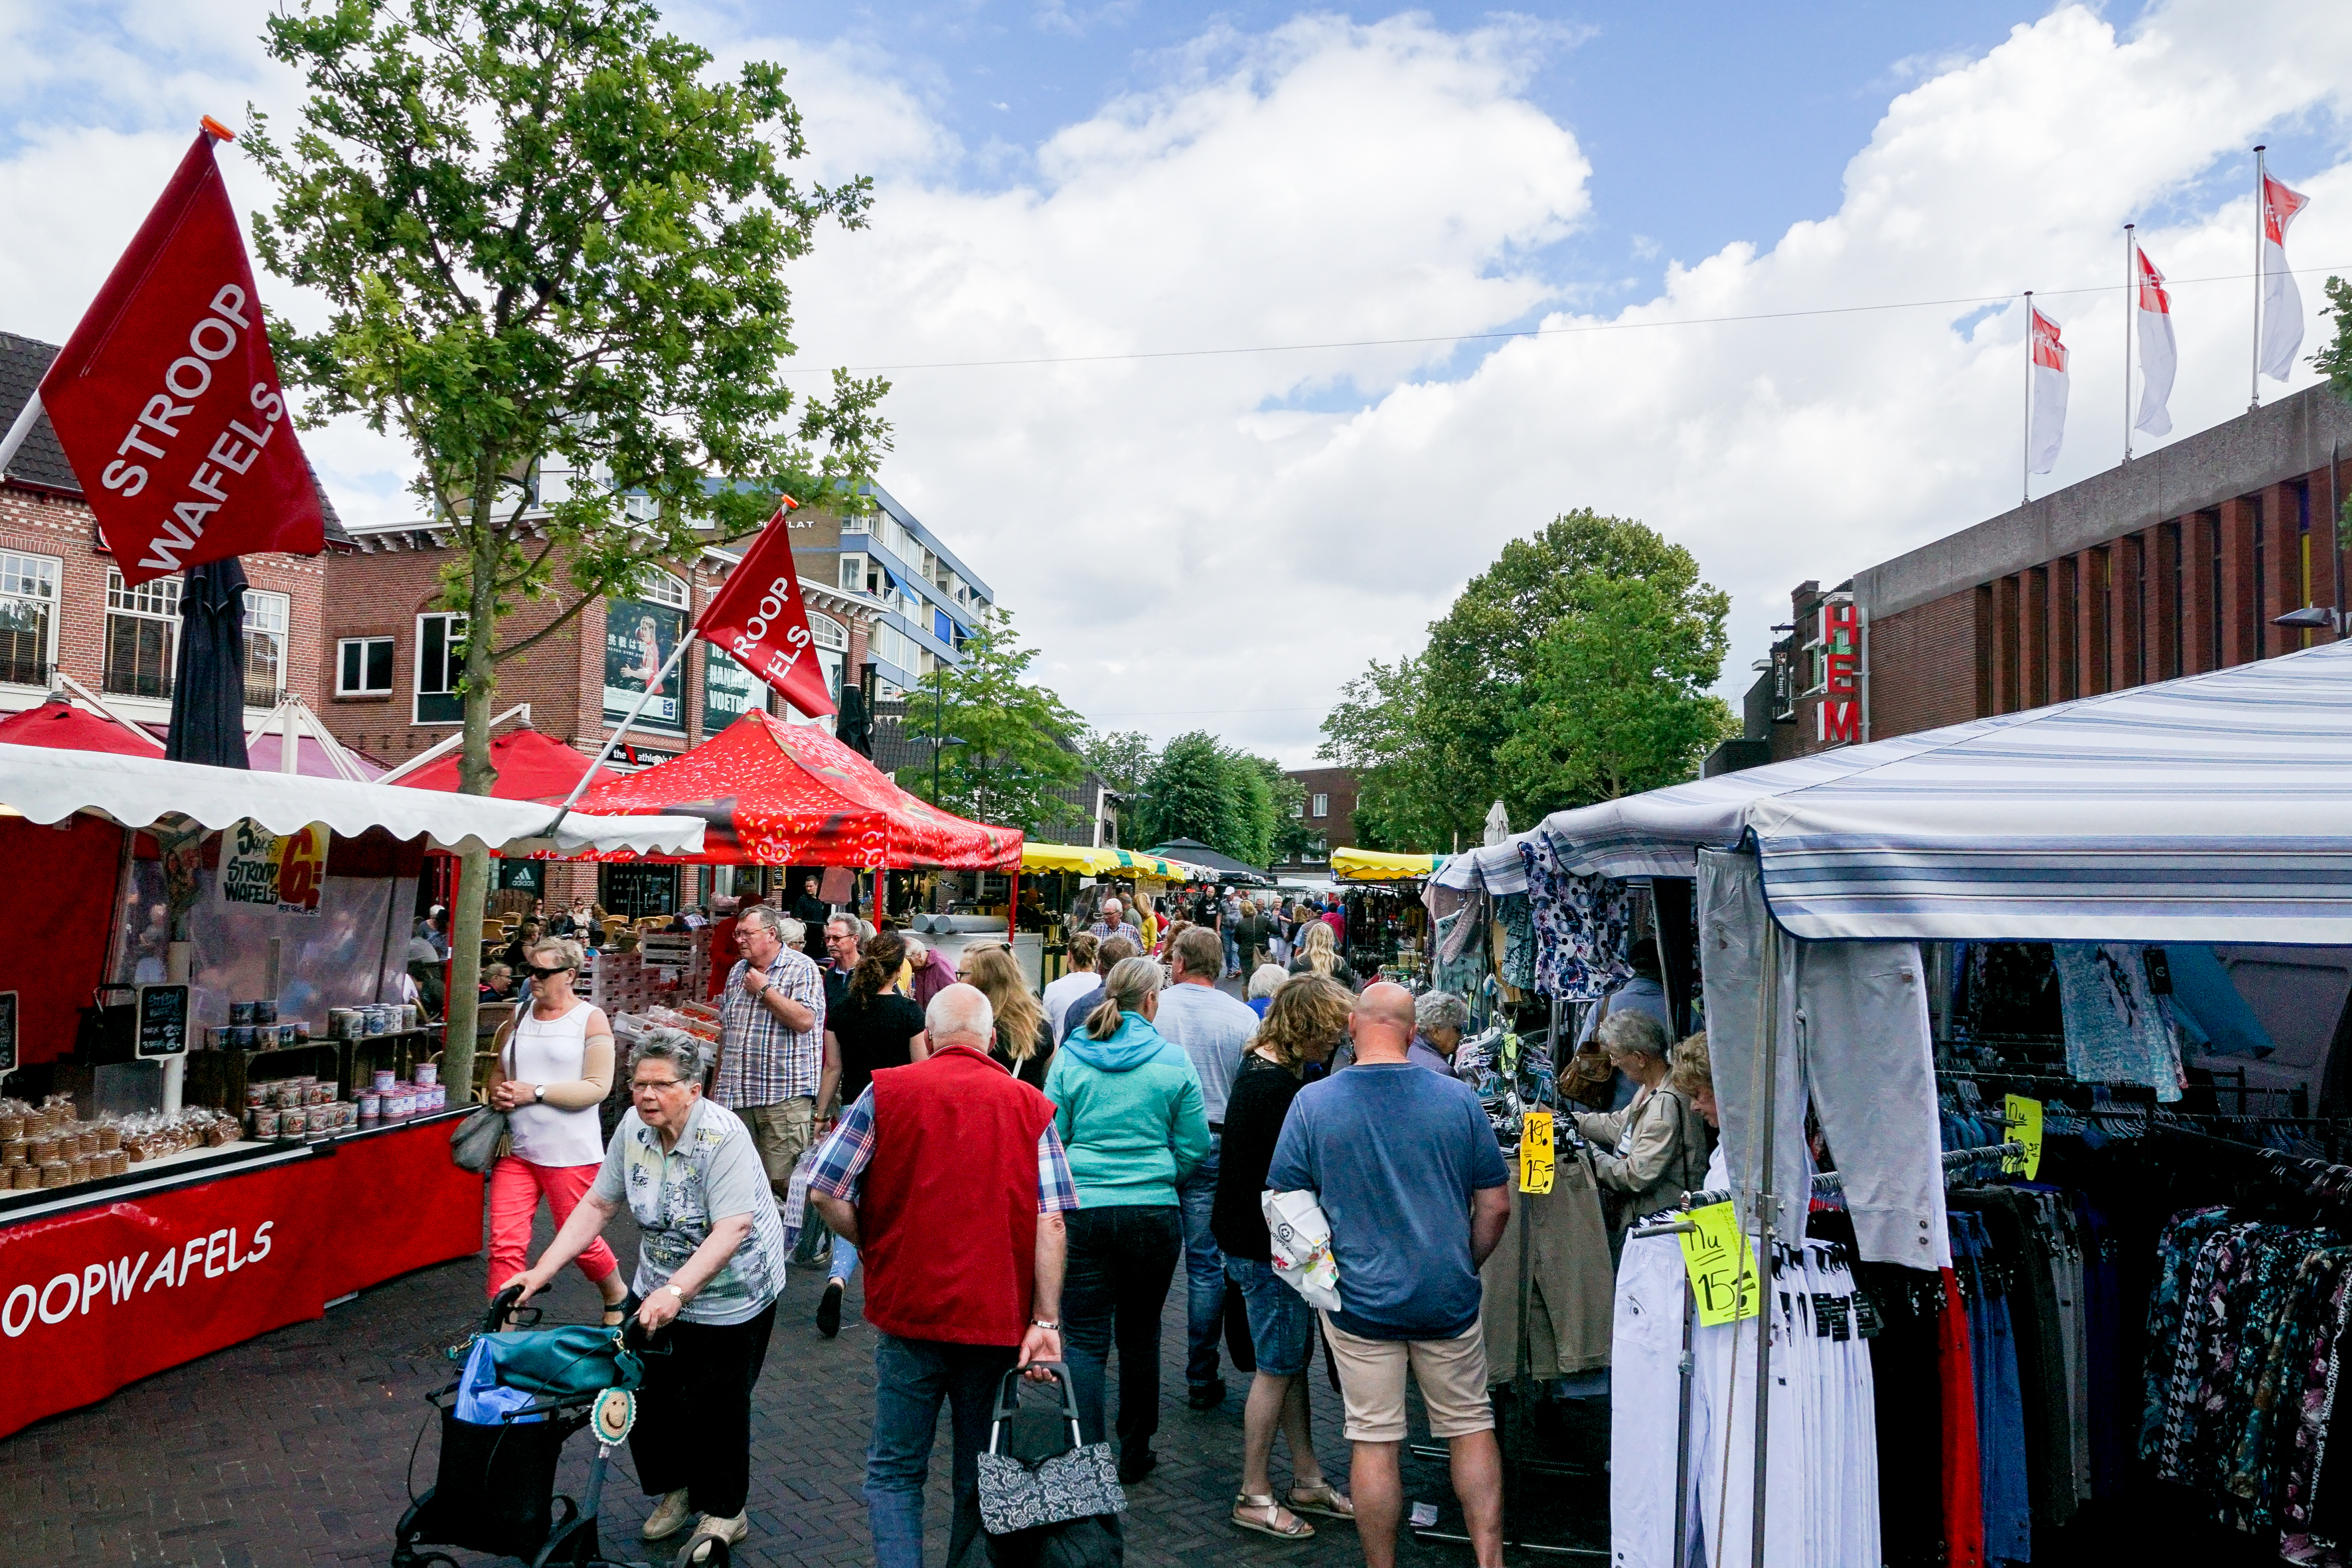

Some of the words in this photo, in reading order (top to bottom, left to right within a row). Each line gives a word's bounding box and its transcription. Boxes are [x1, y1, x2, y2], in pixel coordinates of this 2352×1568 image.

[102, 283, 250, 497] STROOP
[137, 382, 284, 572] WAFELS
[1820, 605, 1859, 741] HEM
[613, 749, 627, 759] the
[222, 881, 279, 905] WAFELS
[226, 856, 279, 885] STROOP
[1, 1220, 275, 1338] OOPWAFELS
